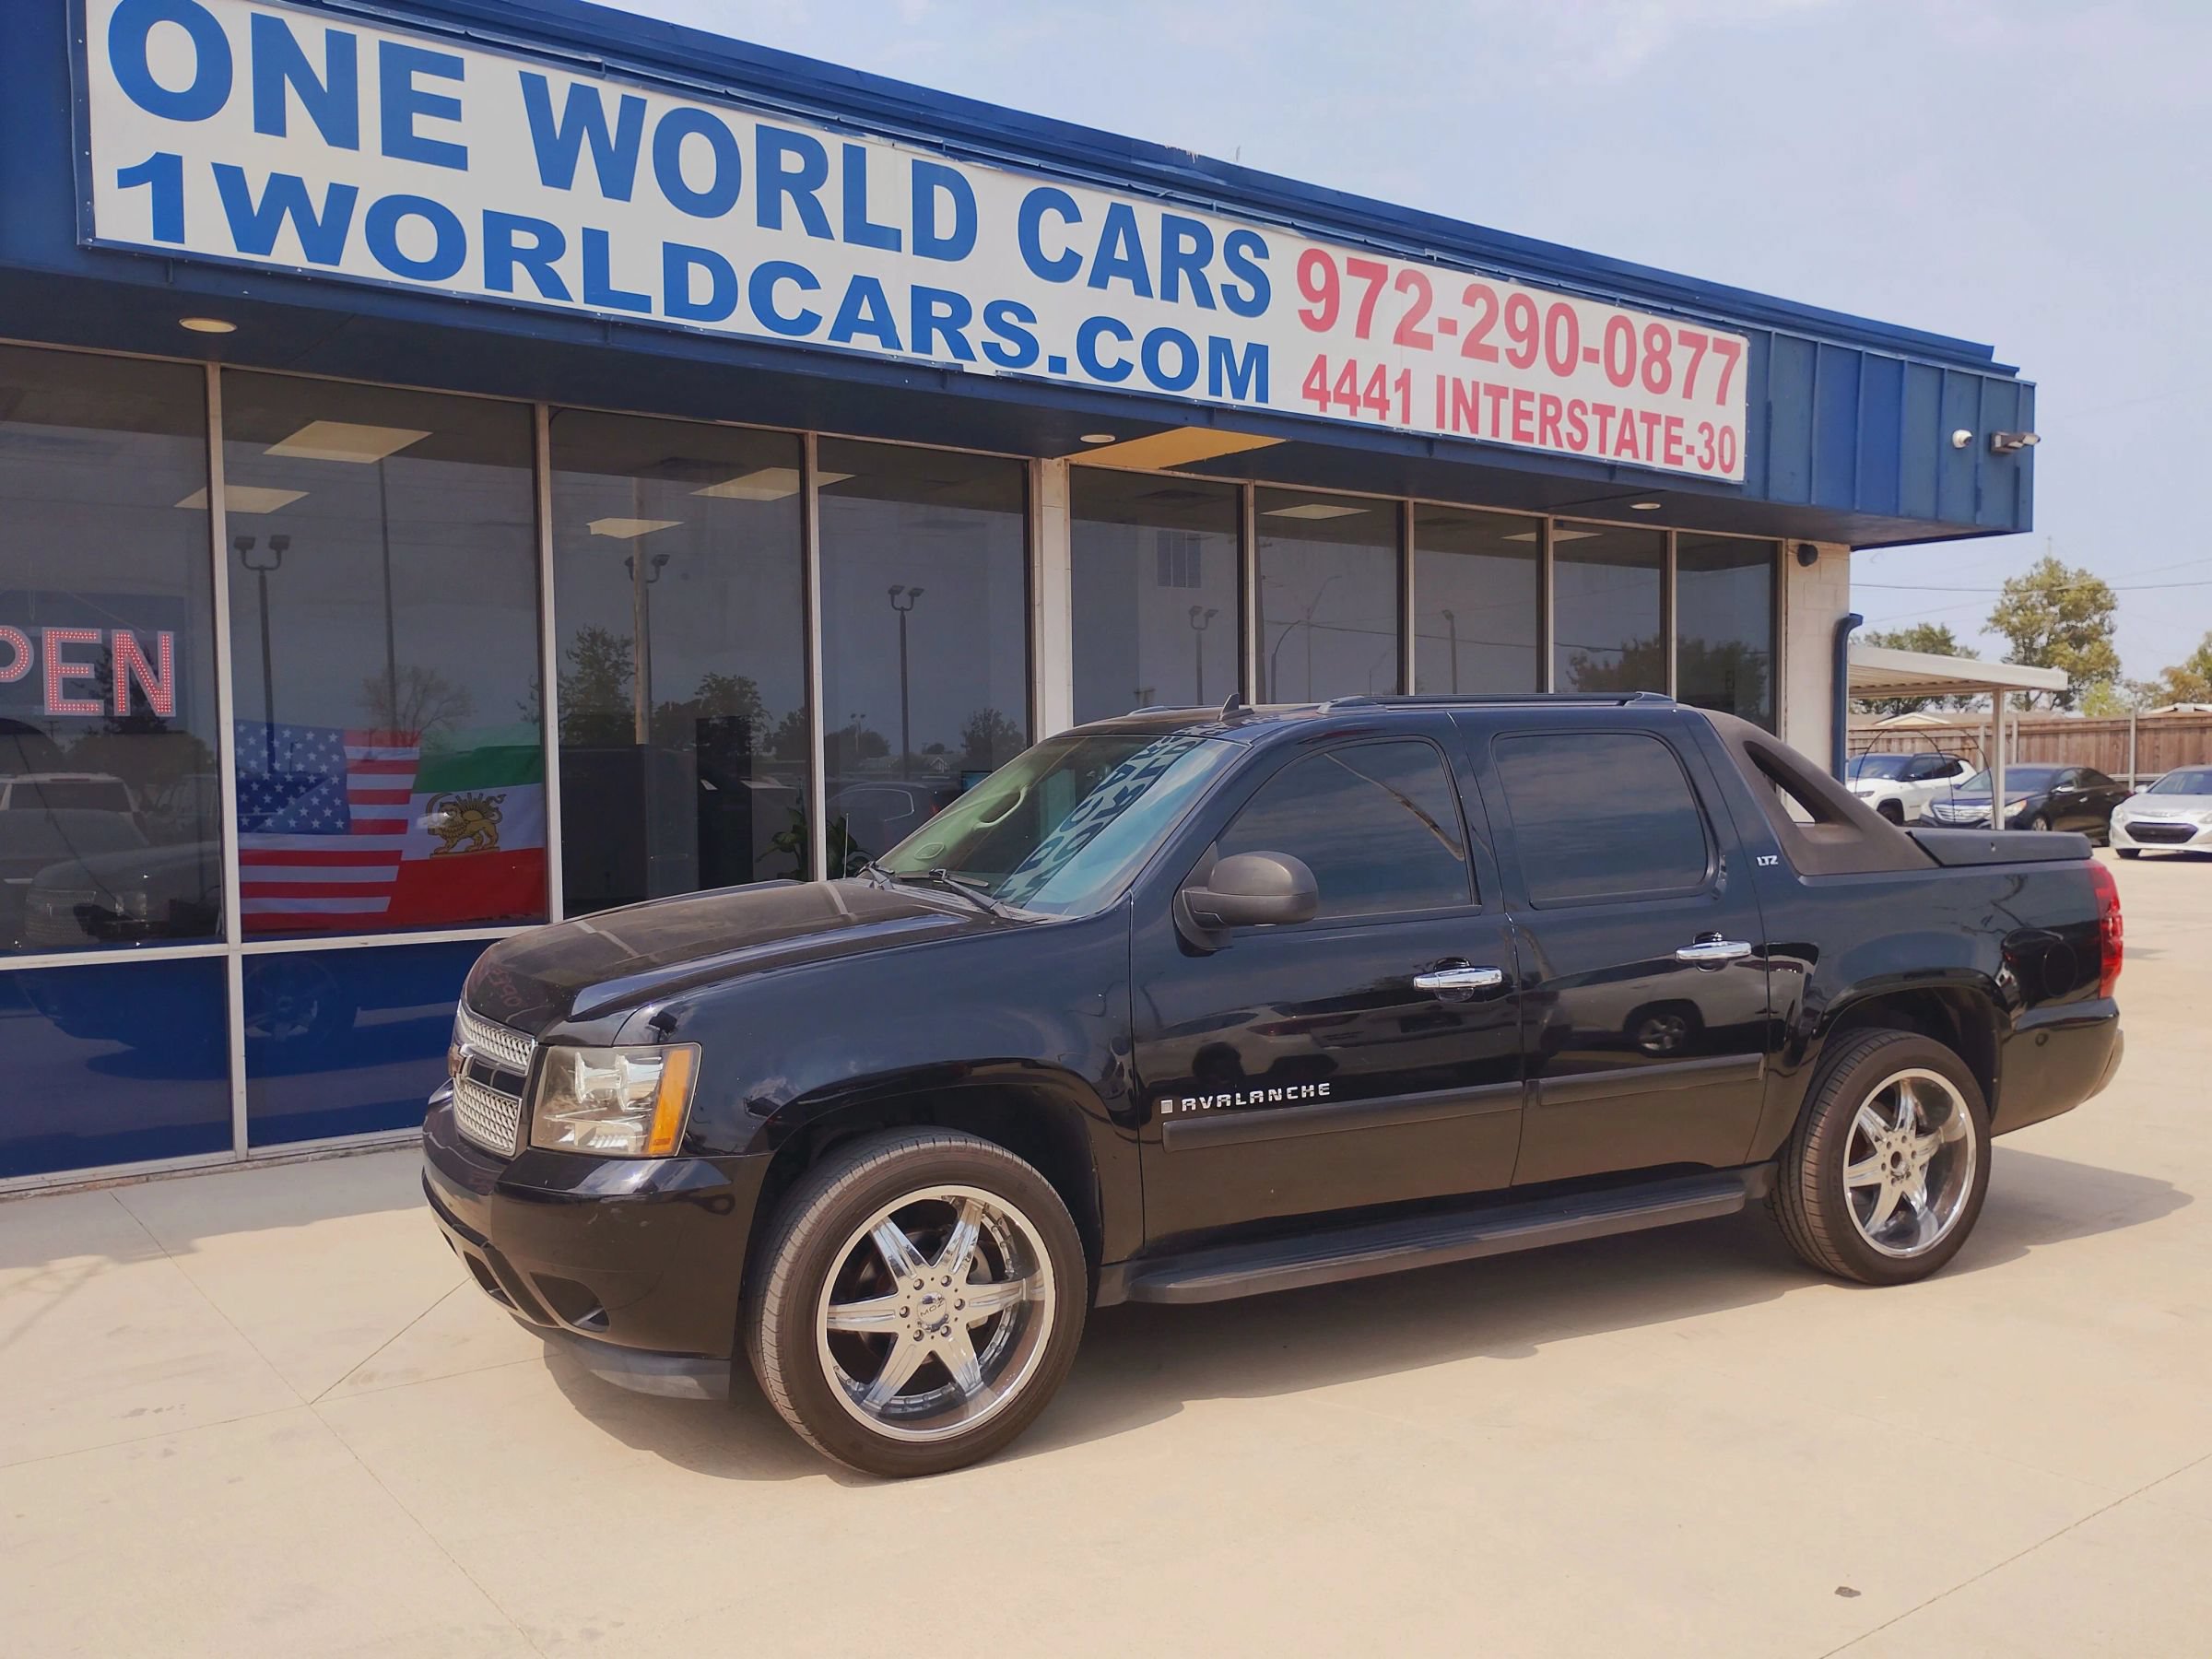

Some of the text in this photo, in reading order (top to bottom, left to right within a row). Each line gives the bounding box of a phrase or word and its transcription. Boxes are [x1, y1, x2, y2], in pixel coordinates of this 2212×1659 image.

[108, 0, 1272, 318] ONE WORLD CARS
[117, 152, 1269, 405] 1WORLDCARS.COM
[1297, 248, 1741, 406] 972-290-0877
[1301, 354, 1736, 475] 4441 INTERSTATE-30
[1757, 855, 1779, 866] LTZ
[1182, 1082, 1331, 1112] AVALANCHE
